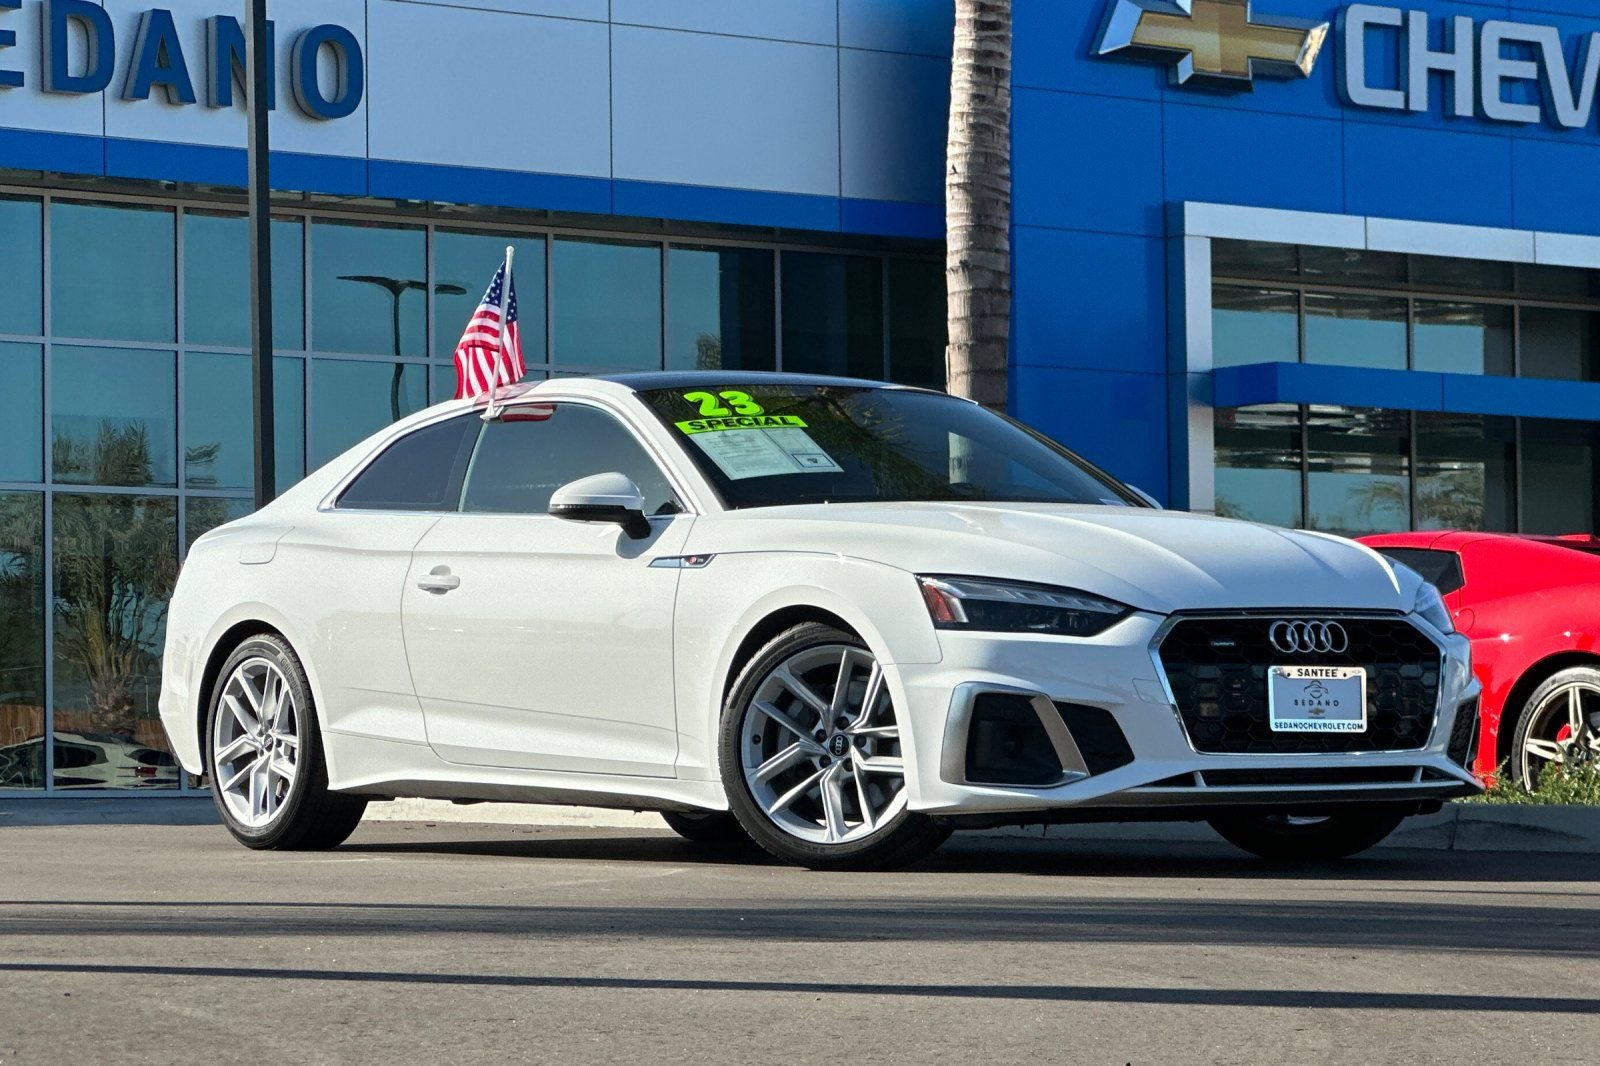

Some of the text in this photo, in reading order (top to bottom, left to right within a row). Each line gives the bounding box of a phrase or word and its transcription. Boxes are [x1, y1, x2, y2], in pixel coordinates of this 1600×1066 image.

[1344, 2, 1600, 128] CHEV
[683, 391, 764, 418] 23
[687, 417, 796, 431] SPECIAL
[1297, 668, 1338, 678] SANTEE
[1294, 699, 1340, 707] SEDANO
[1274, 722, 1364, 730] SEDANOCHEVROLET.COM
